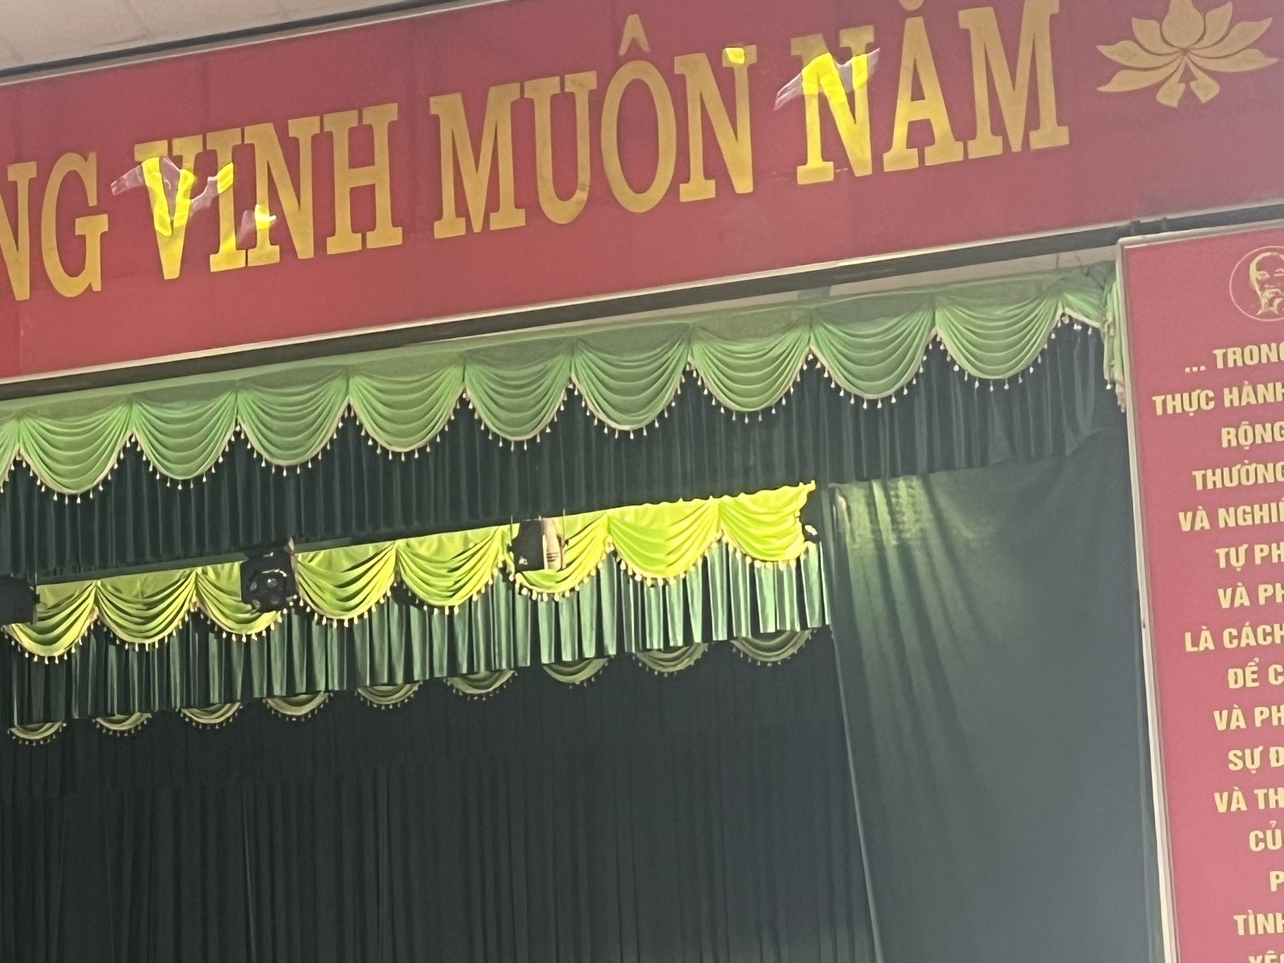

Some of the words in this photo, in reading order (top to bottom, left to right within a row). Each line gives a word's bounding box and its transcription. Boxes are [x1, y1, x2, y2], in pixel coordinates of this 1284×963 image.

[134, 103, 403, 280] VINH
[431, 13, 757, 240] MUÔN
[790, 0, 1069, 185] NĂM
[1152, 389, 1215, 416] THỰC
[1178, 505, 1211, 532] VÀ
[1215, 544, 1248, 571] TỰ
[1217, 582, 1251, 609] VÀ
[1184, 625, 1215, 652] LÀ
[1227, 657, 1260, 689] ĐỂ
[1213, 704, 1247, 731] VÀ
[1228, 746, 1263, 774] SỰ
[1214, 786, 1247, 813] VÀ
